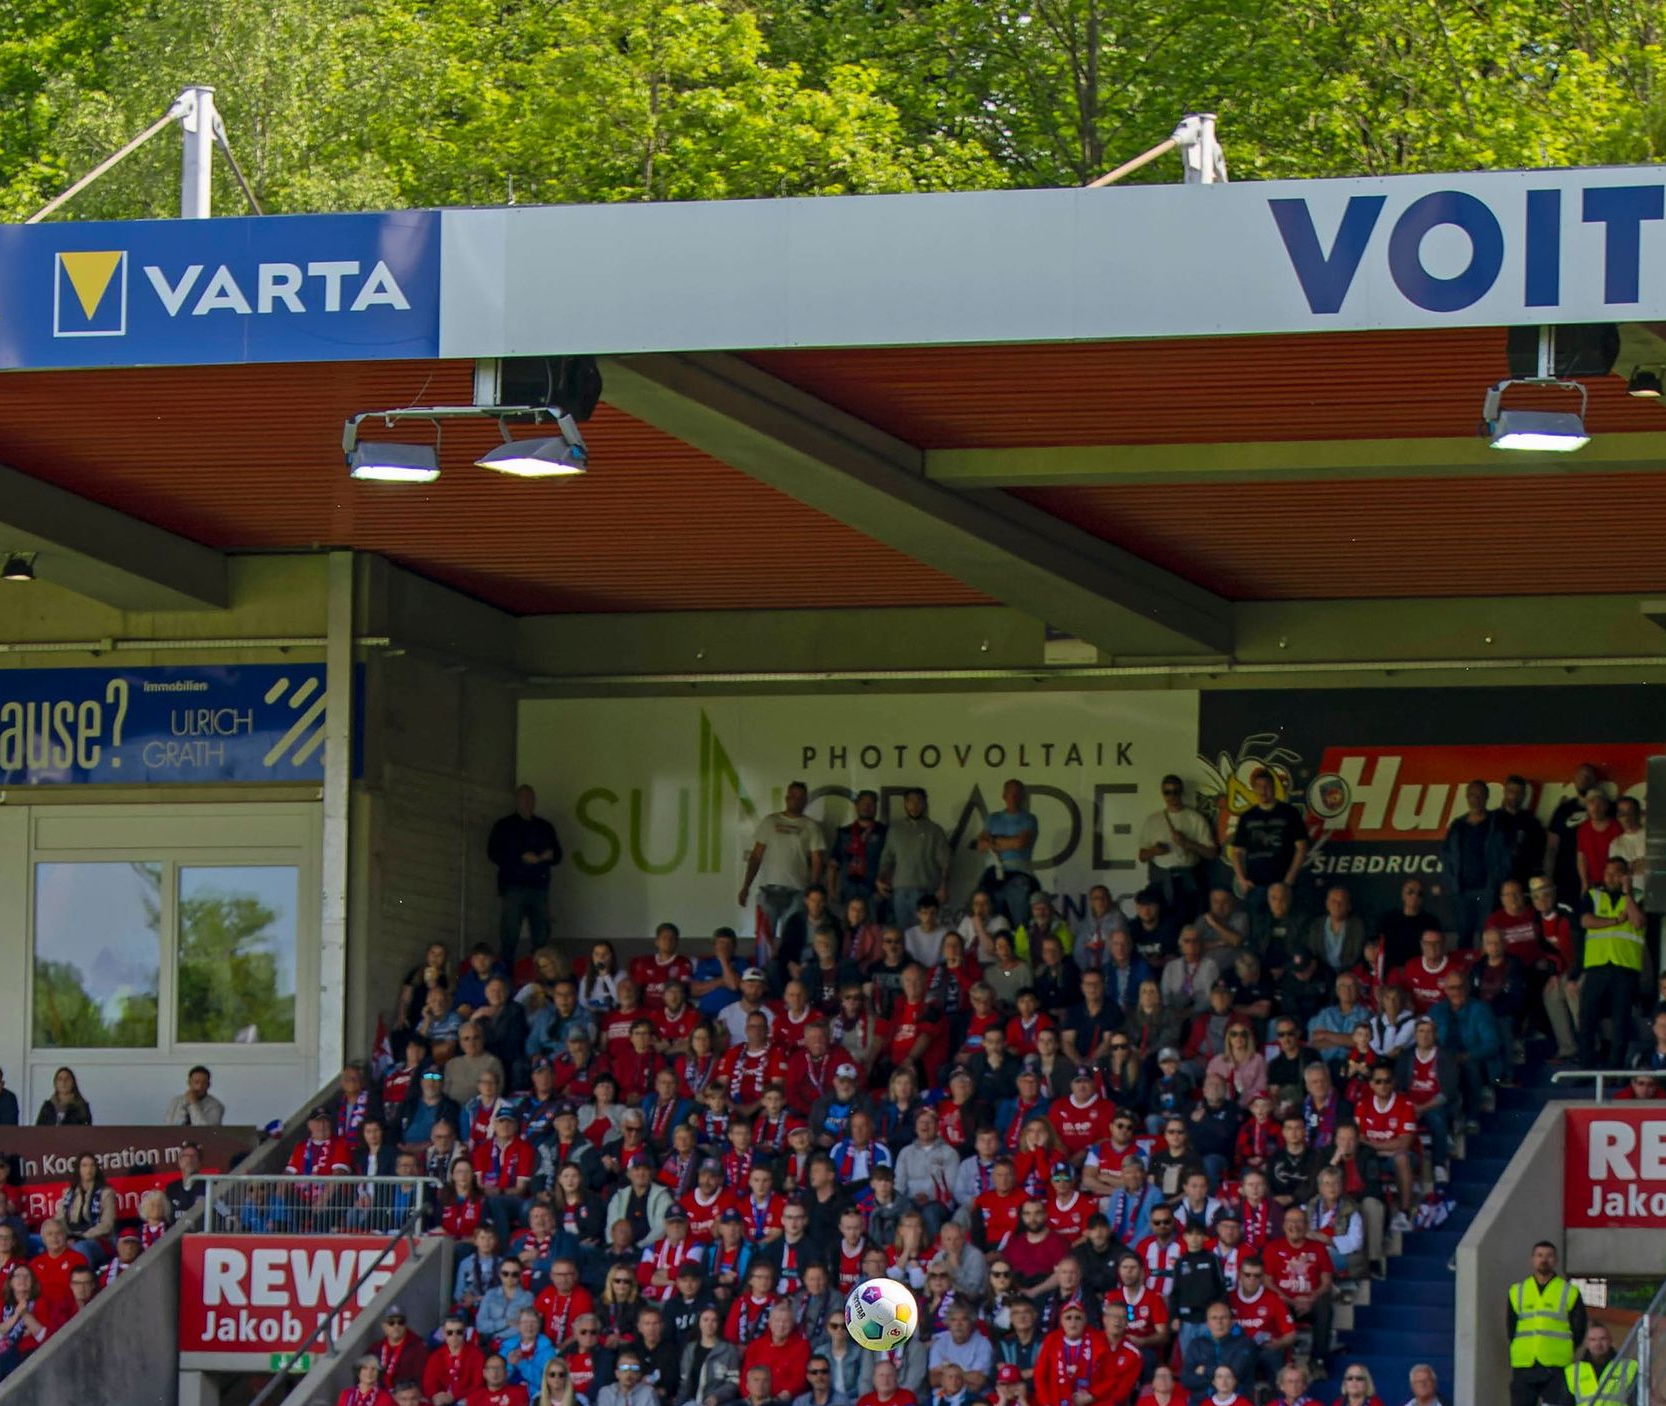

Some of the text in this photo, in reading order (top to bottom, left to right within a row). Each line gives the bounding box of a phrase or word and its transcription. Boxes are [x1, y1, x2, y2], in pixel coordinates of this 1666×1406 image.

[145, 259, 410, 317] VARTA
[143, 680, 208, 693] Immobilien
[170, 708, 253, 737] ULRICH
[142, 741, 225, 769] GRATH
[802, 741, 1135, 769] PHOTOVOLTAIK
[20, 1158, 37, 1178] In
[201, 1310, 301, 1343] Jakob
